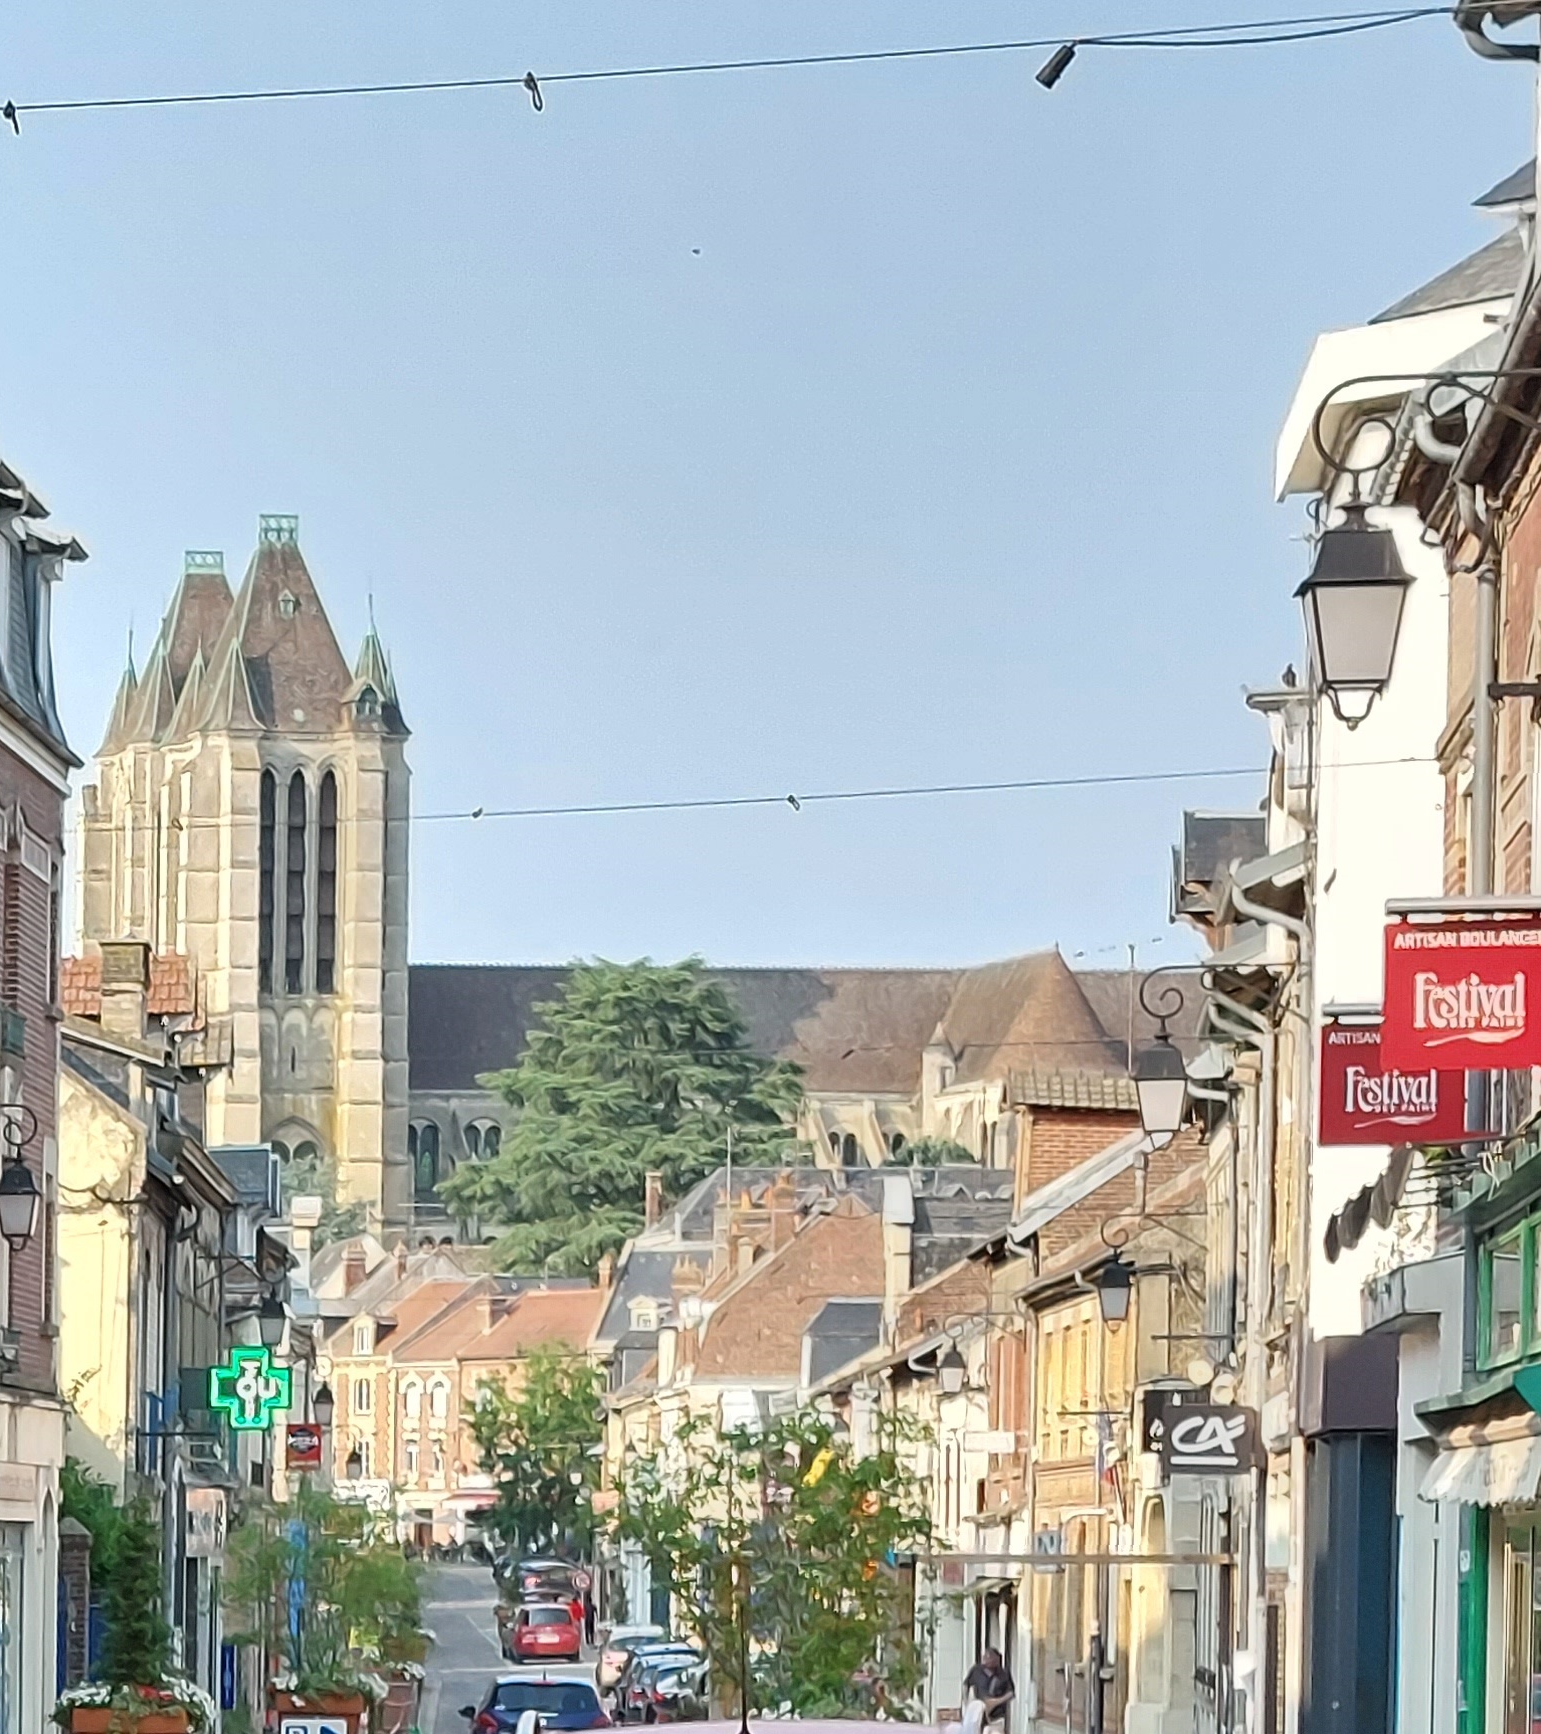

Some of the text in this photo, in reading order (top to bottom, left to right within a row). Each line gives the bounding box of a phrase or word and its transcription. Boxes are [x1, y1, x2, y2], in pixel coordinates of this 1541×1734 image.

[1393, 930, 1541, 949] ARTISAN BOULANGE
[1413, 970, 1526, 1029] Festival
[1328, 1031, 1381, 1046] ARTISAN
[1345, 1066, 1438, 1113] Festival
